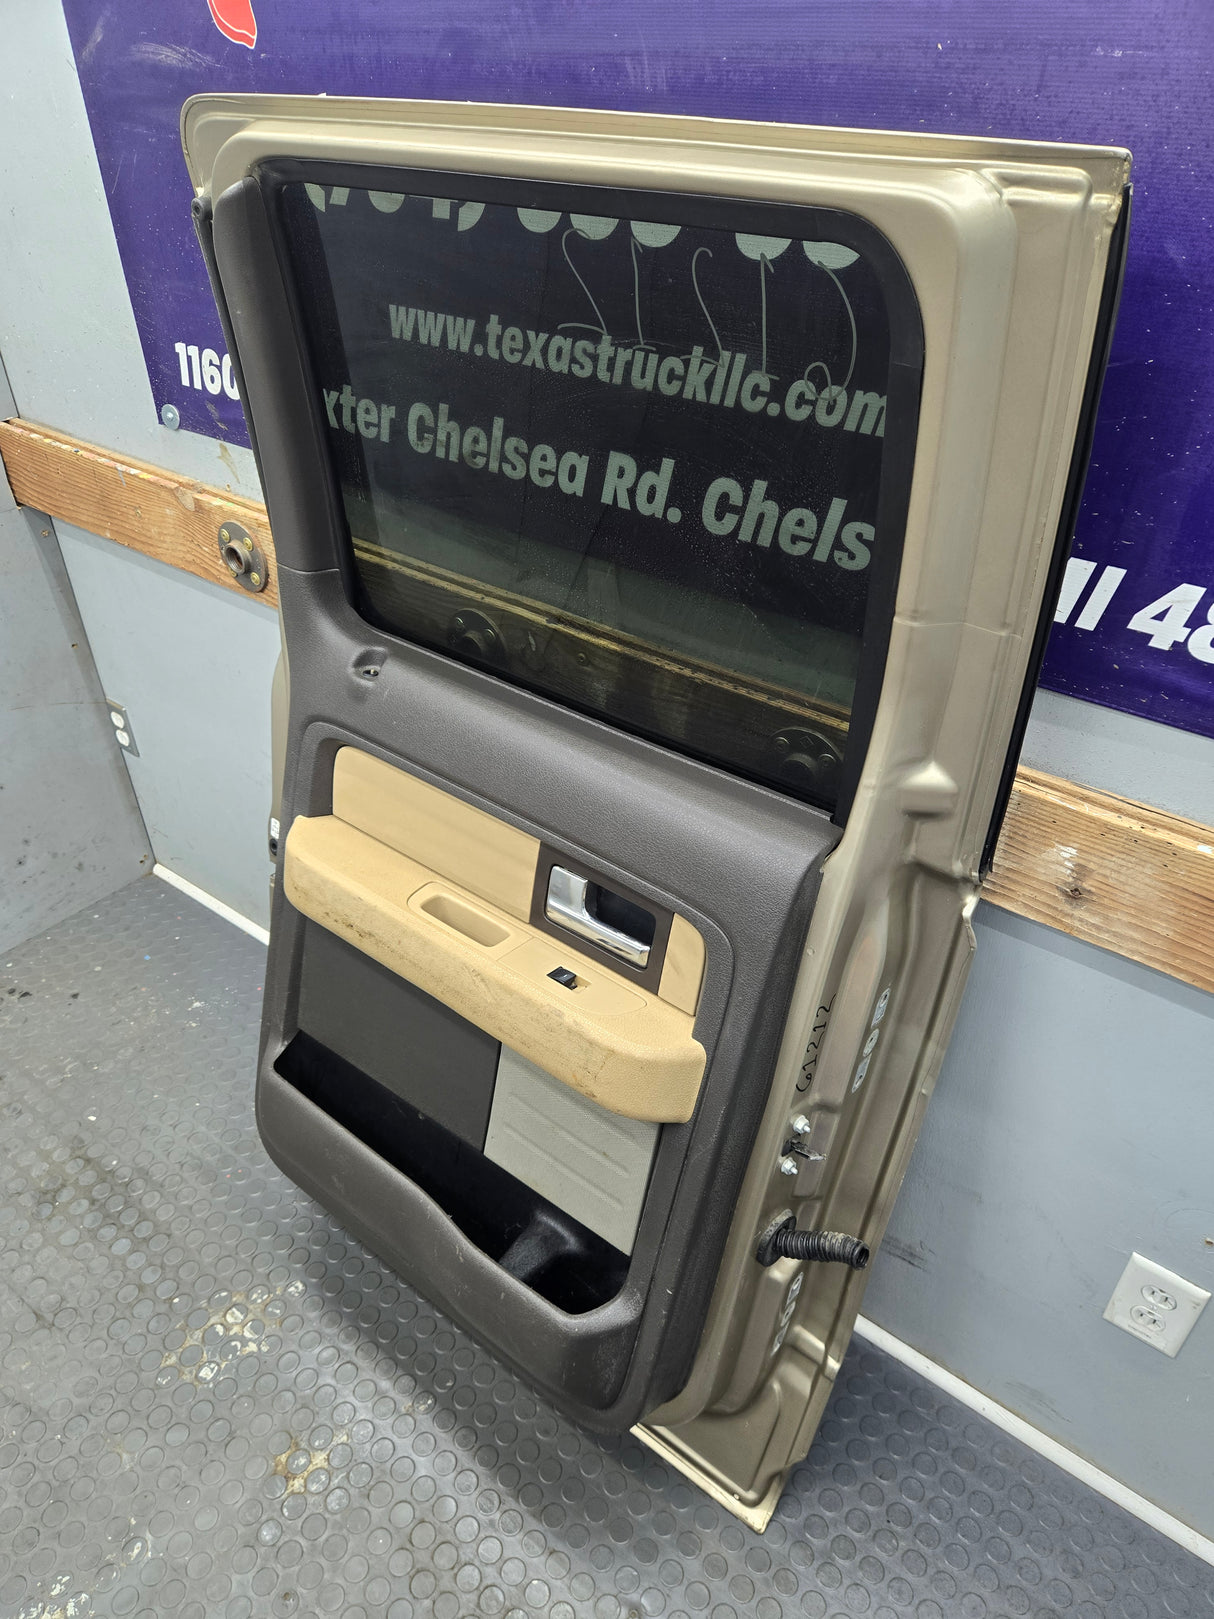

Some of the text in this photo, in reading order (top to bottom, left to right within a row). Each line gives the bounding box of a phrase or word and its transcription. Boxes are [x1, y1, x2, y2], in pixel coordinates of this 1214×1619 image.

[407, 402, 589, 497] Chelsea
[600, 451, 682, 523] Rd.
[701, 478, 876, 571] Chels
